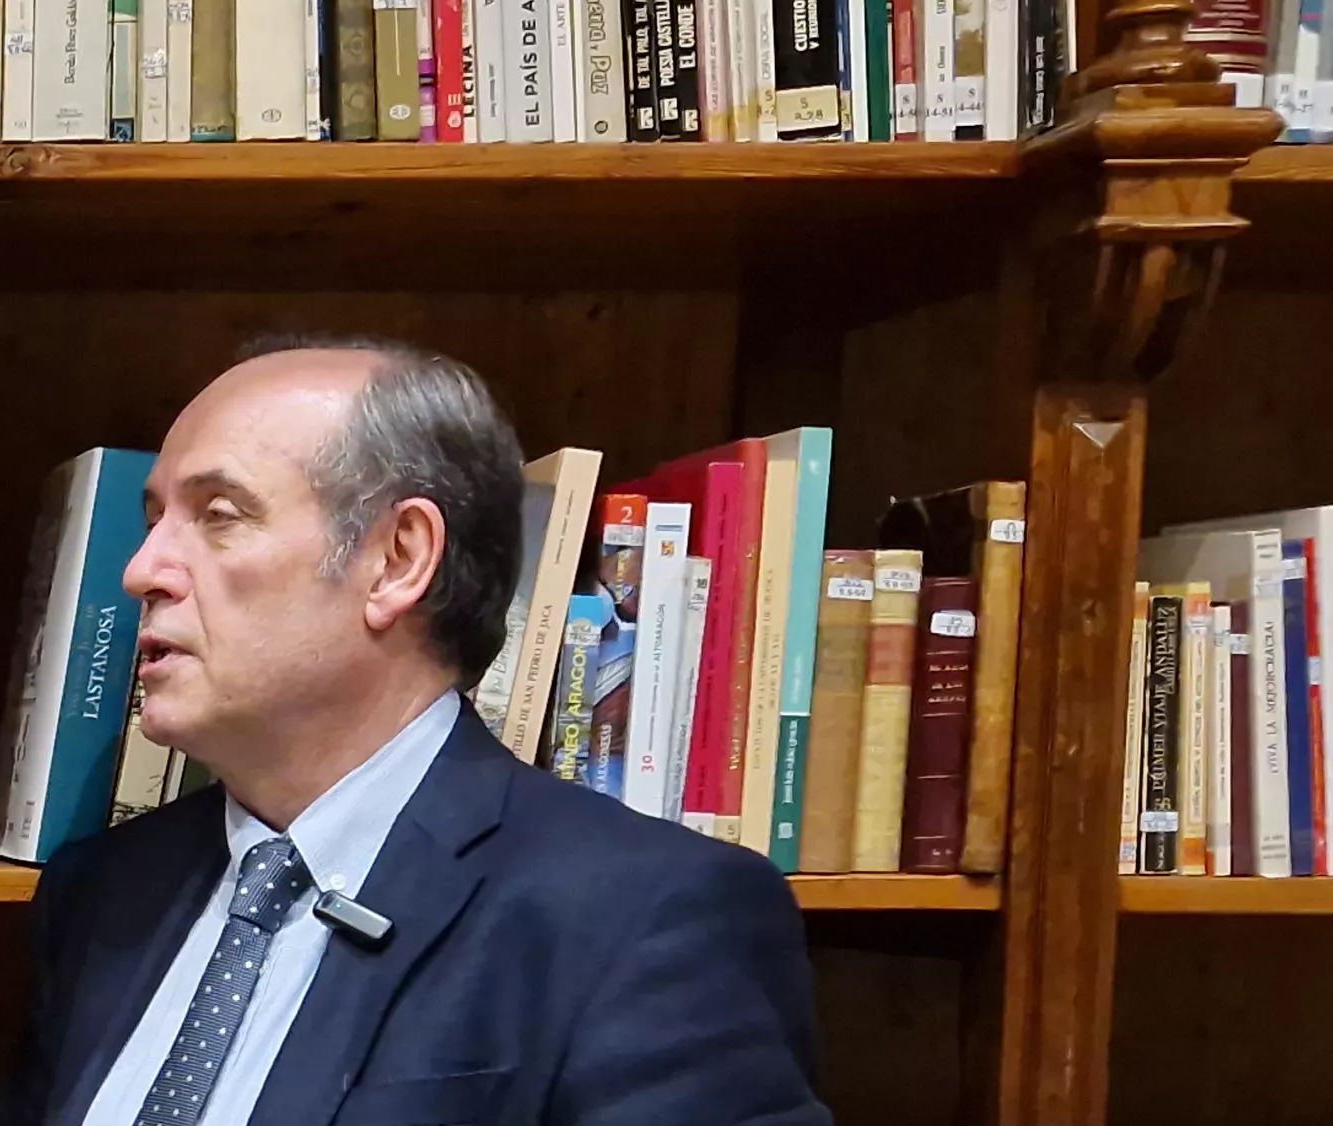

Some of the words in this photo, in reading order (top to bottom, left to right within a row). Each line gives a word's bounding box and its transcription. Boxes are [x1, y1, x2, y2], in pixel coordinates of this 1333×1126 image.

[520, 18, 537, 46] DE
[677, 3, 694, 47] CONDE
[678, 51, 695, 68] EL
[460, 44, 475, 117] LECINA
[518, 52, 539, 96] PAÍS
[524, 101, 540, 125] EL
[620, 505, 633, 523] 2
[539, 602, 553, 628] JACA
[536, 628, 547, 645] DE
[81, 602, 117, 719] LASTANOSA
[527, 646, 542, 682] PEDRO
[523, 683, 535, 704] SAN
[519, 706, 530, 722] DE
[1267, 721, 1277, 735] LA
[641, 755, 655, 773] 30
